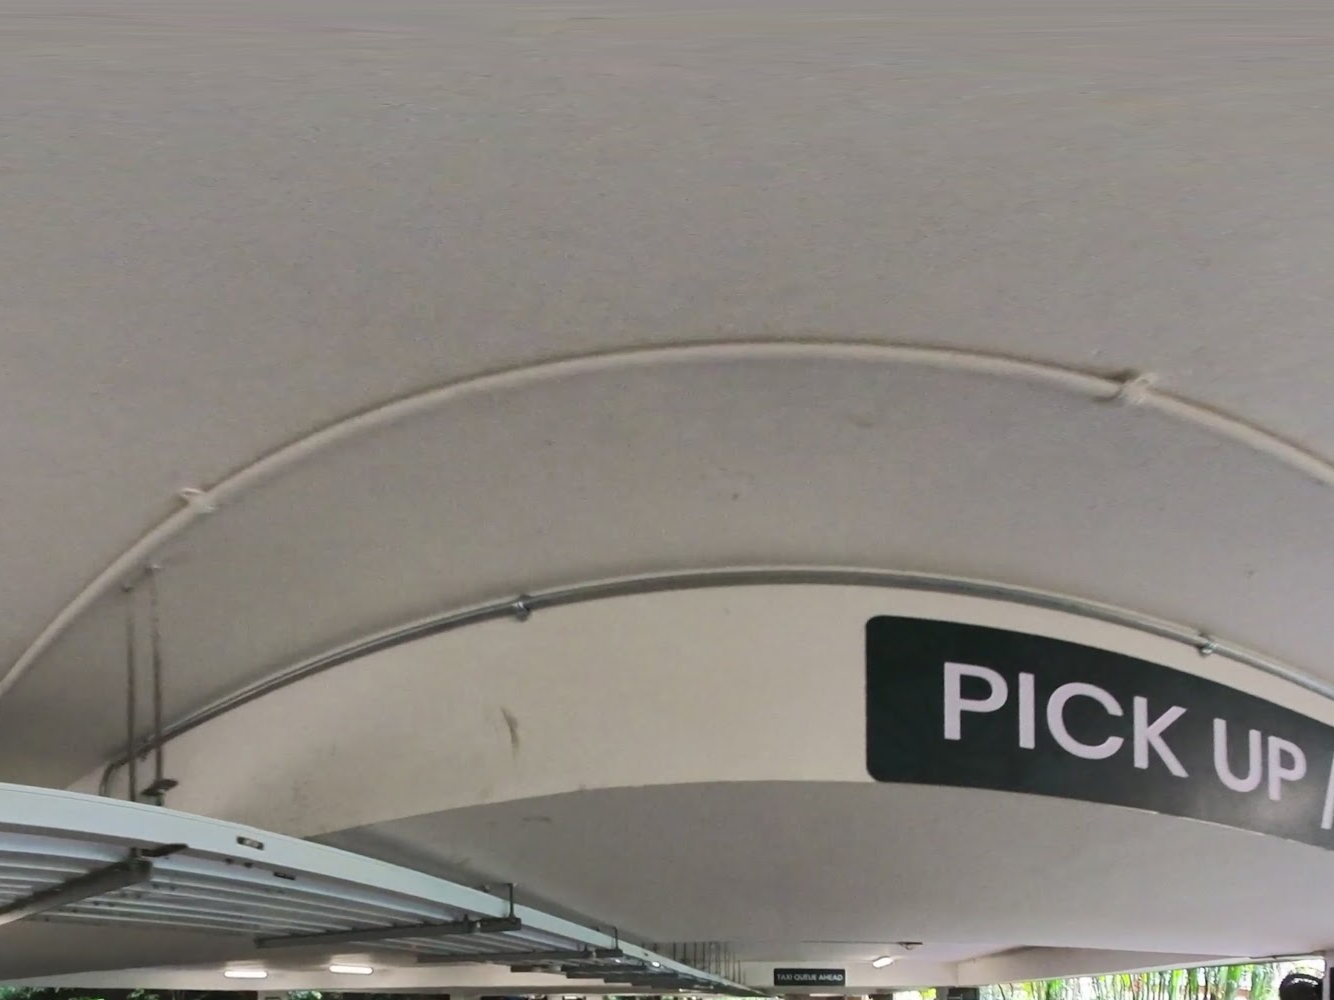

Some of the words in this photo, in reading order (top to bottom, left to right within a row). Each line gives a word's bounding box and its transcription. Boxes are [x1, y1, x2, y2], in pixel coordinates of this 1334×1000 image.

[943, 661, 1189, 778] PICK
[1213, 717, 1307, 801] UP
[777, 973, 792, 981] TAXI
[794, 973, 817, 981] QUEUE
[818, 973, 844, 982] AHEAD
